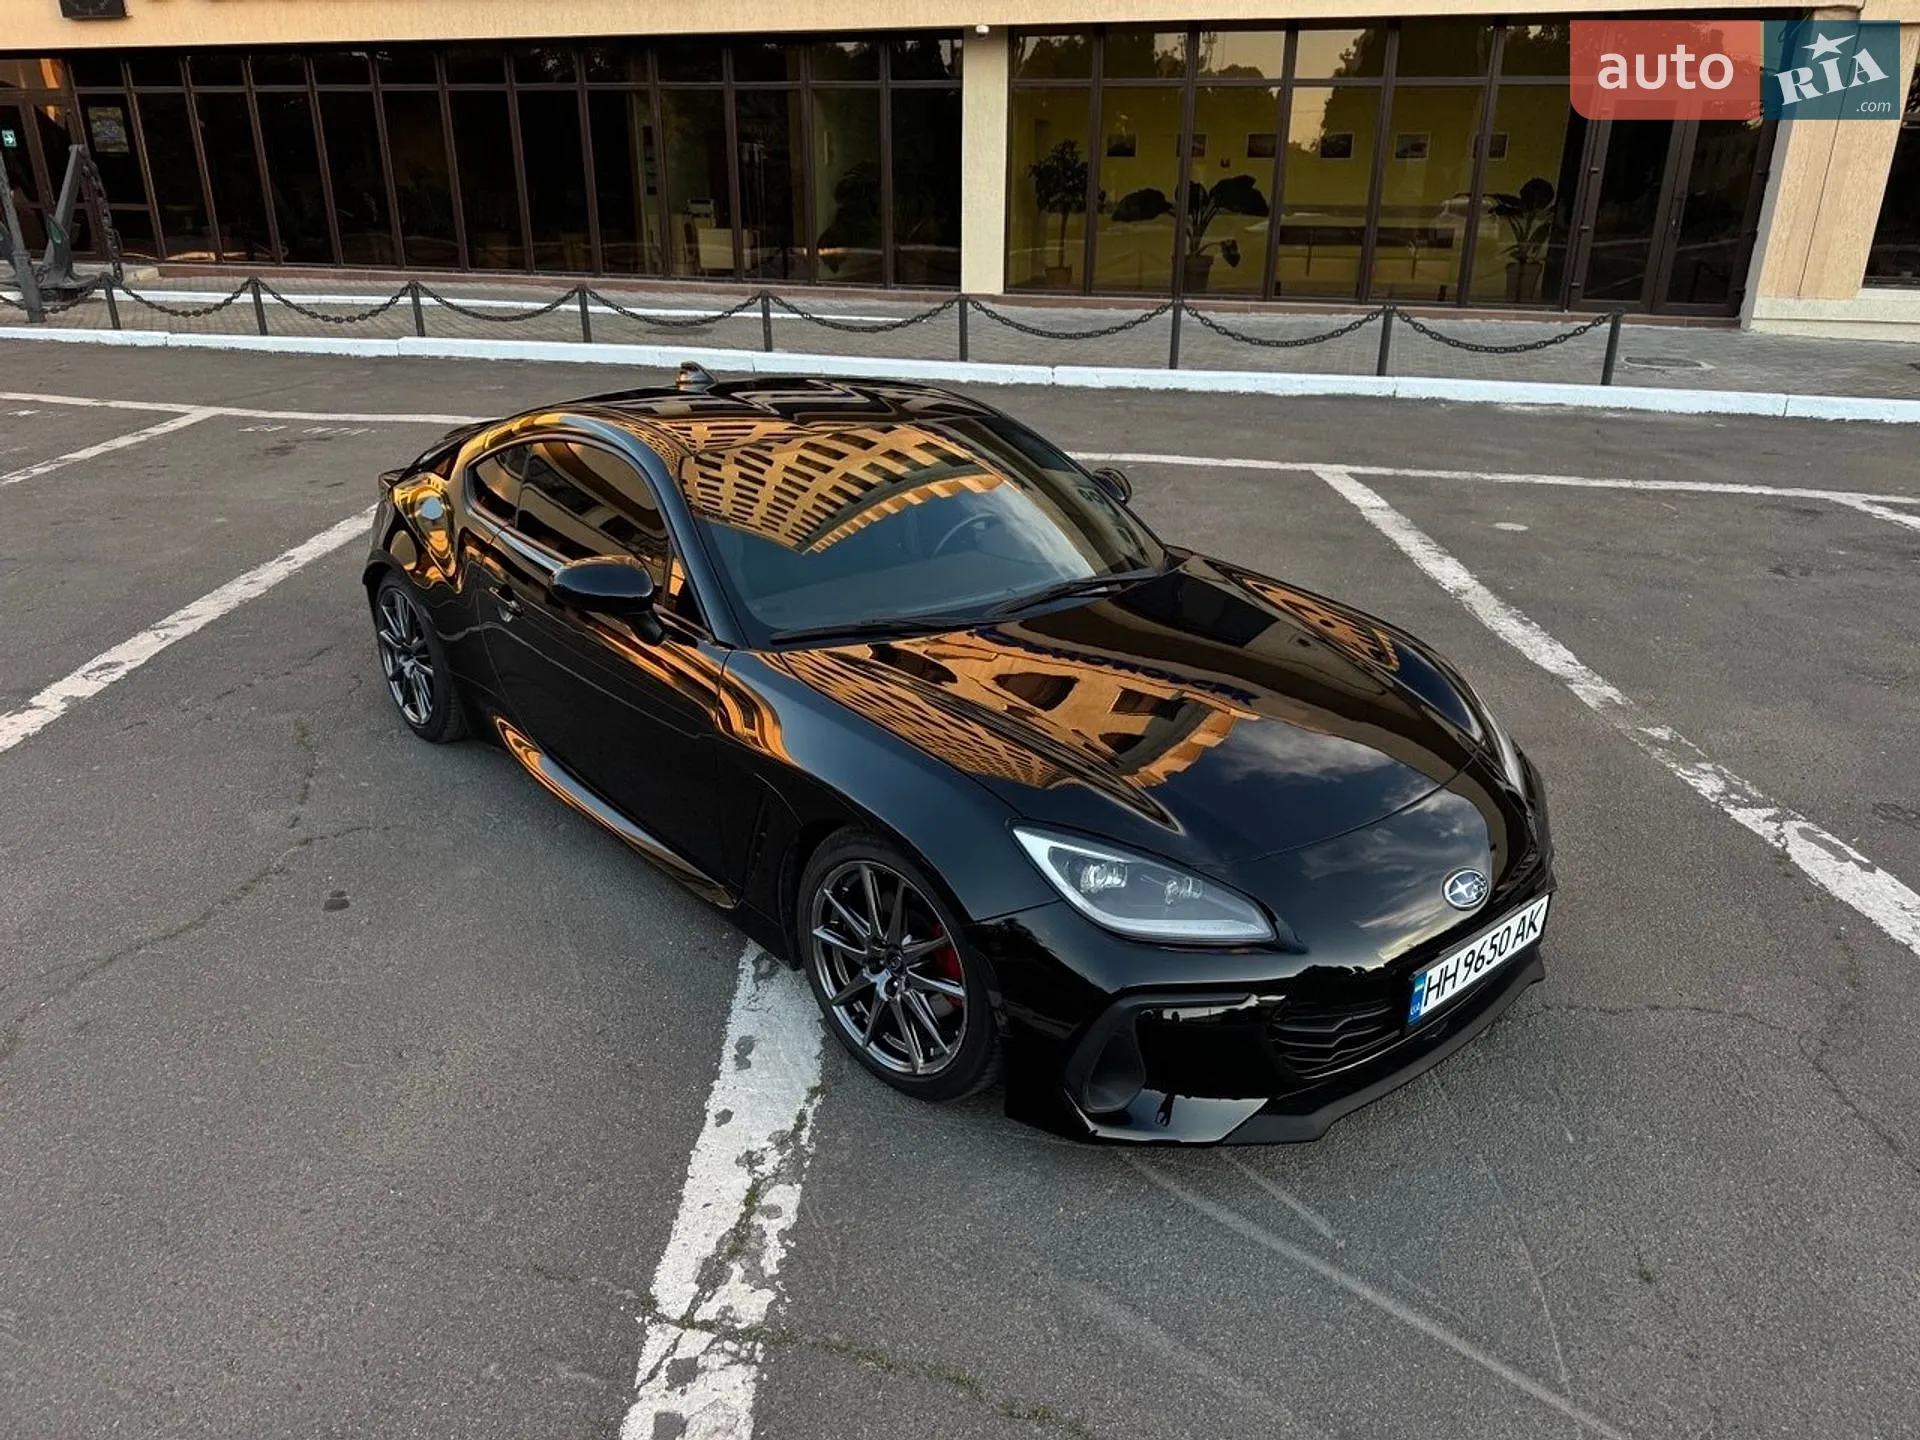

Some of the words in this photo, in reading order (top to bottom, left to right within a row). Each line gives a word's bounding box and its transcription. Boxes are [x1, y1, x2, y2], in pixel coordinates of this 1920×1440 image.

[1424, 957, 1459, 1007] HH
[1463, 925, 1511, 982] 9650
[1512, 903, 1543, 948] AK
